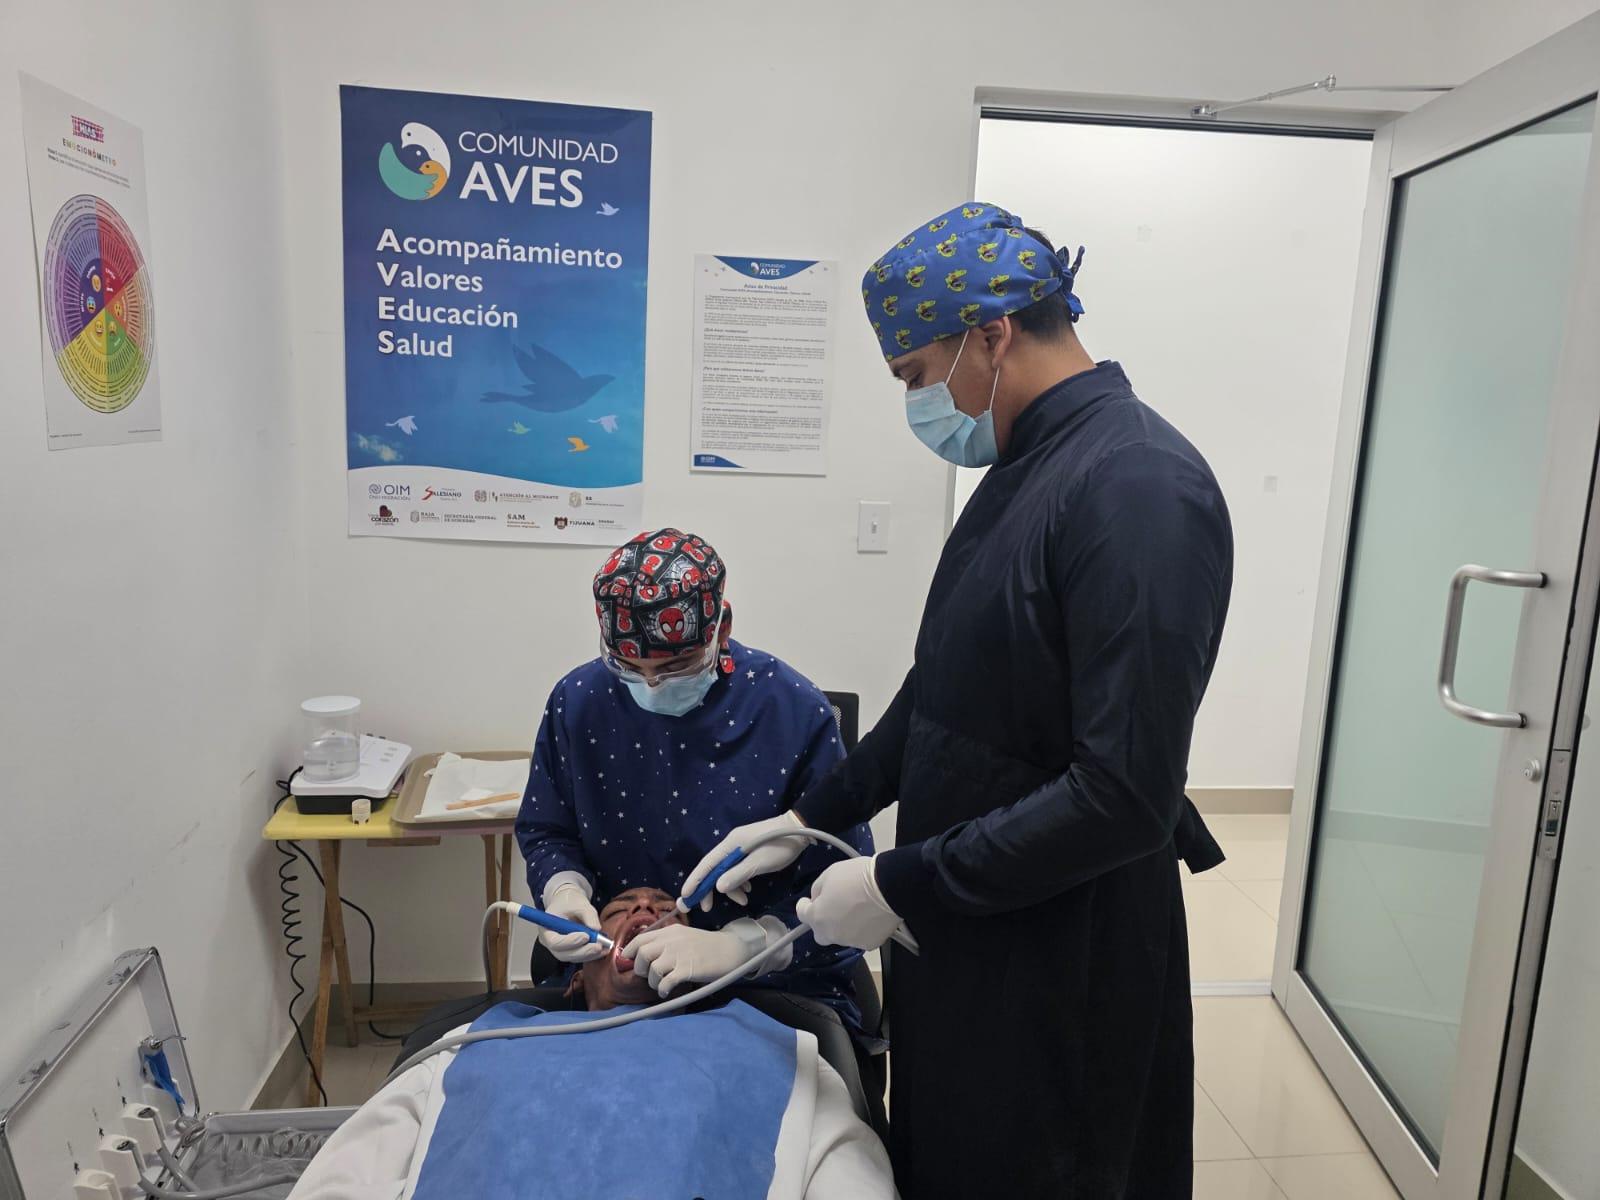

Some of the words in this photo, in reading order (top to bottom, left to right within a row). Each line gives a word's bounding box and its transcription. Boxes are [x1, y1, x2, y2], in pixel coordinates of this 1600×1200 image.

[458, 131, 619, 164] COMUNIDAD
[458, 160, 584, 208] AVES
[376, 228, 623, 269] Acompañamiento
[376, 262, 484, 292] Valores
[759, 268, 781, 276] AVES
[377, 296, 519, 329] Educación
[377, 330, 453, 358] Salud
[383, 484, 411, 496] OIM
[421, 486, 462, 501] SALESIANO
[370, 515, 399, 523] corazón
[507, 513, 526, 521] SAM
